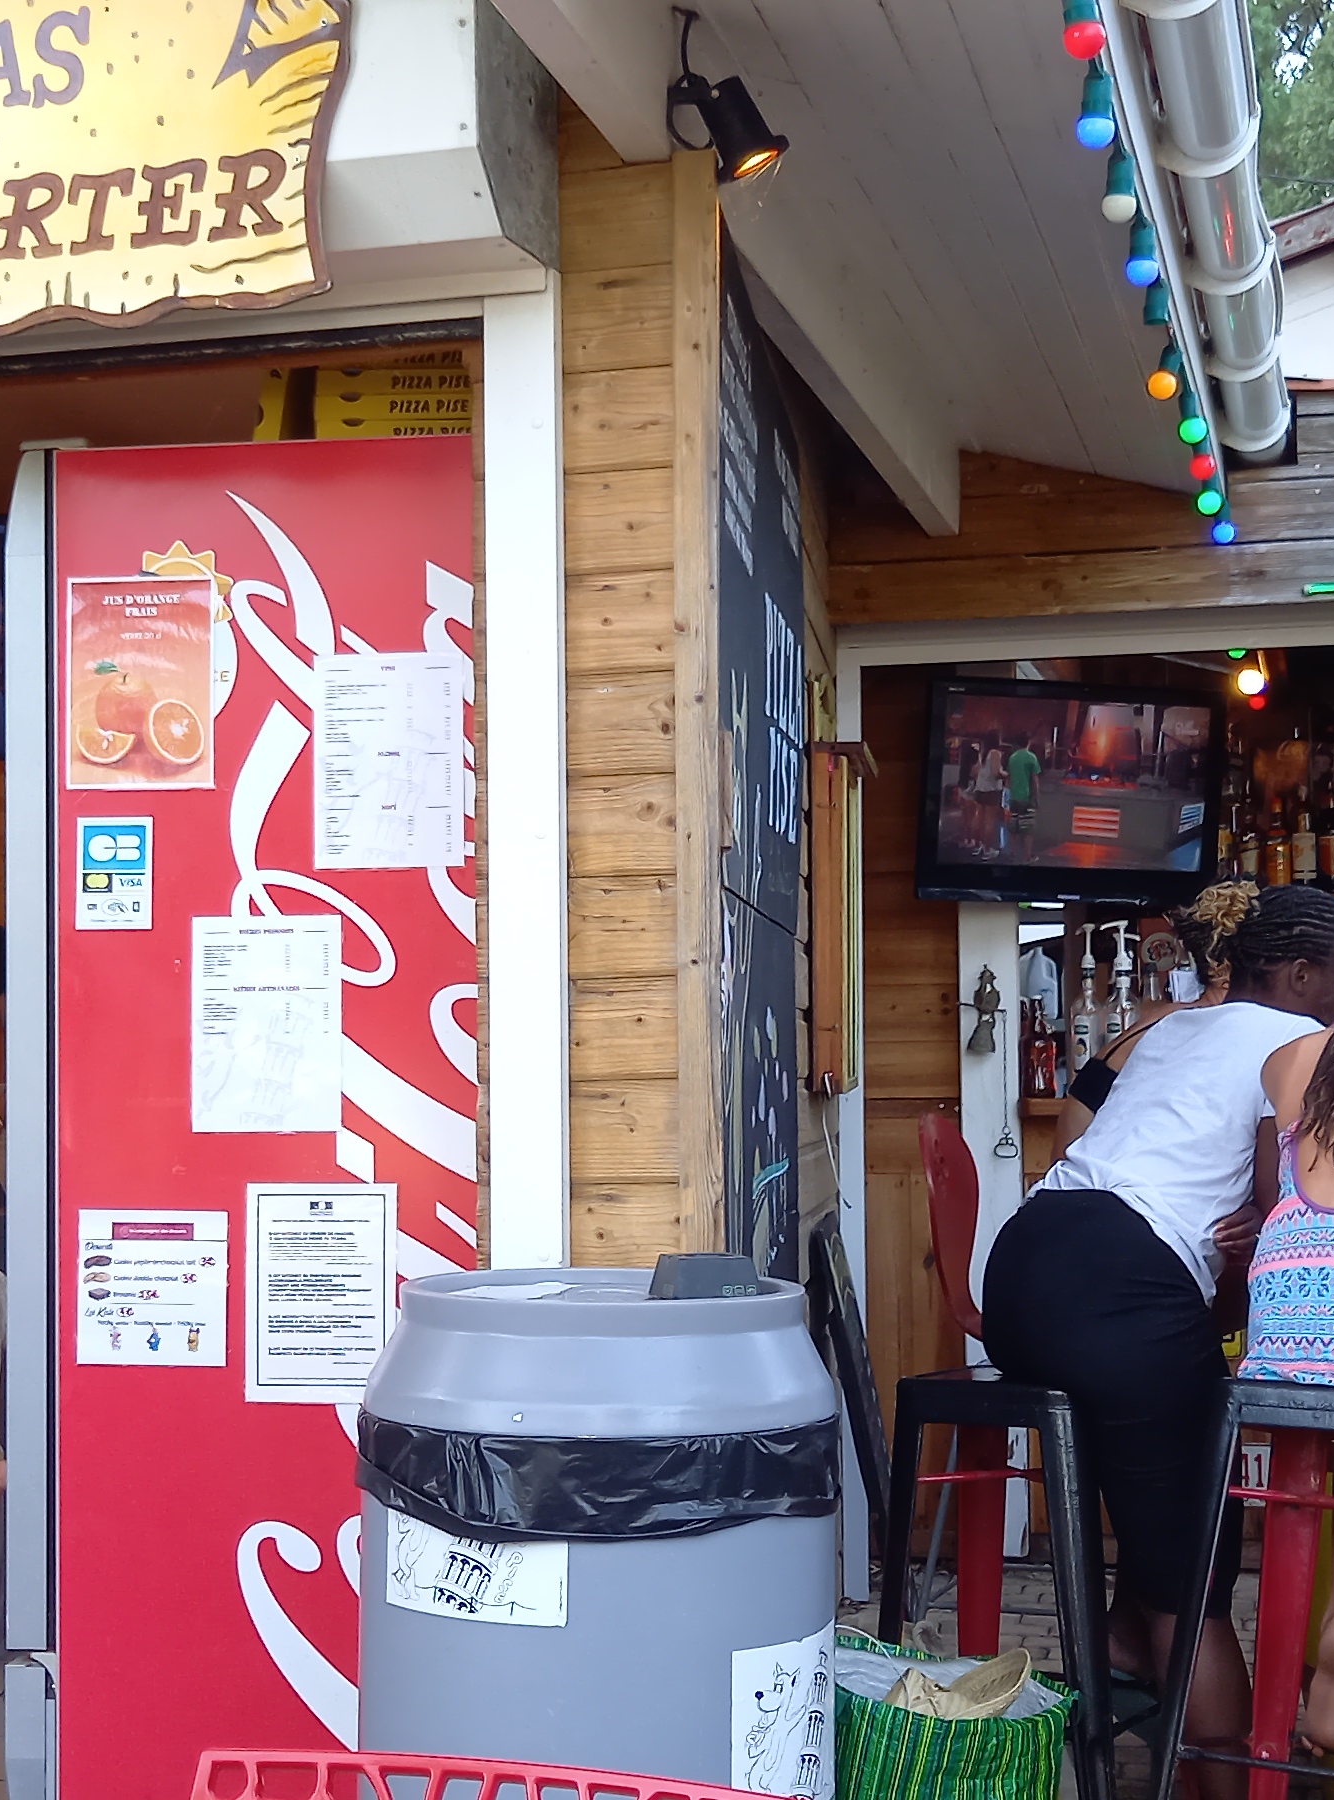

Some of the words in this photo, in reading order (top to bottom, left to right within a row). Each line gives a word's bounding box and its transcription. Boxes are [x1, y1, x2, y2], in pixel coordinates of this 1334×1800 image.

[391, 375, 432, 390] PIZZA
[389, 400, 430, 413] PIZZA
[436, 399, 469, 413] PISE
[764, 591, 804, 749] PIZZA
[768, 726, 798, 844] PISE
[88, 834, 142, 862] CB
[119, 878, 143, 887] VISA
